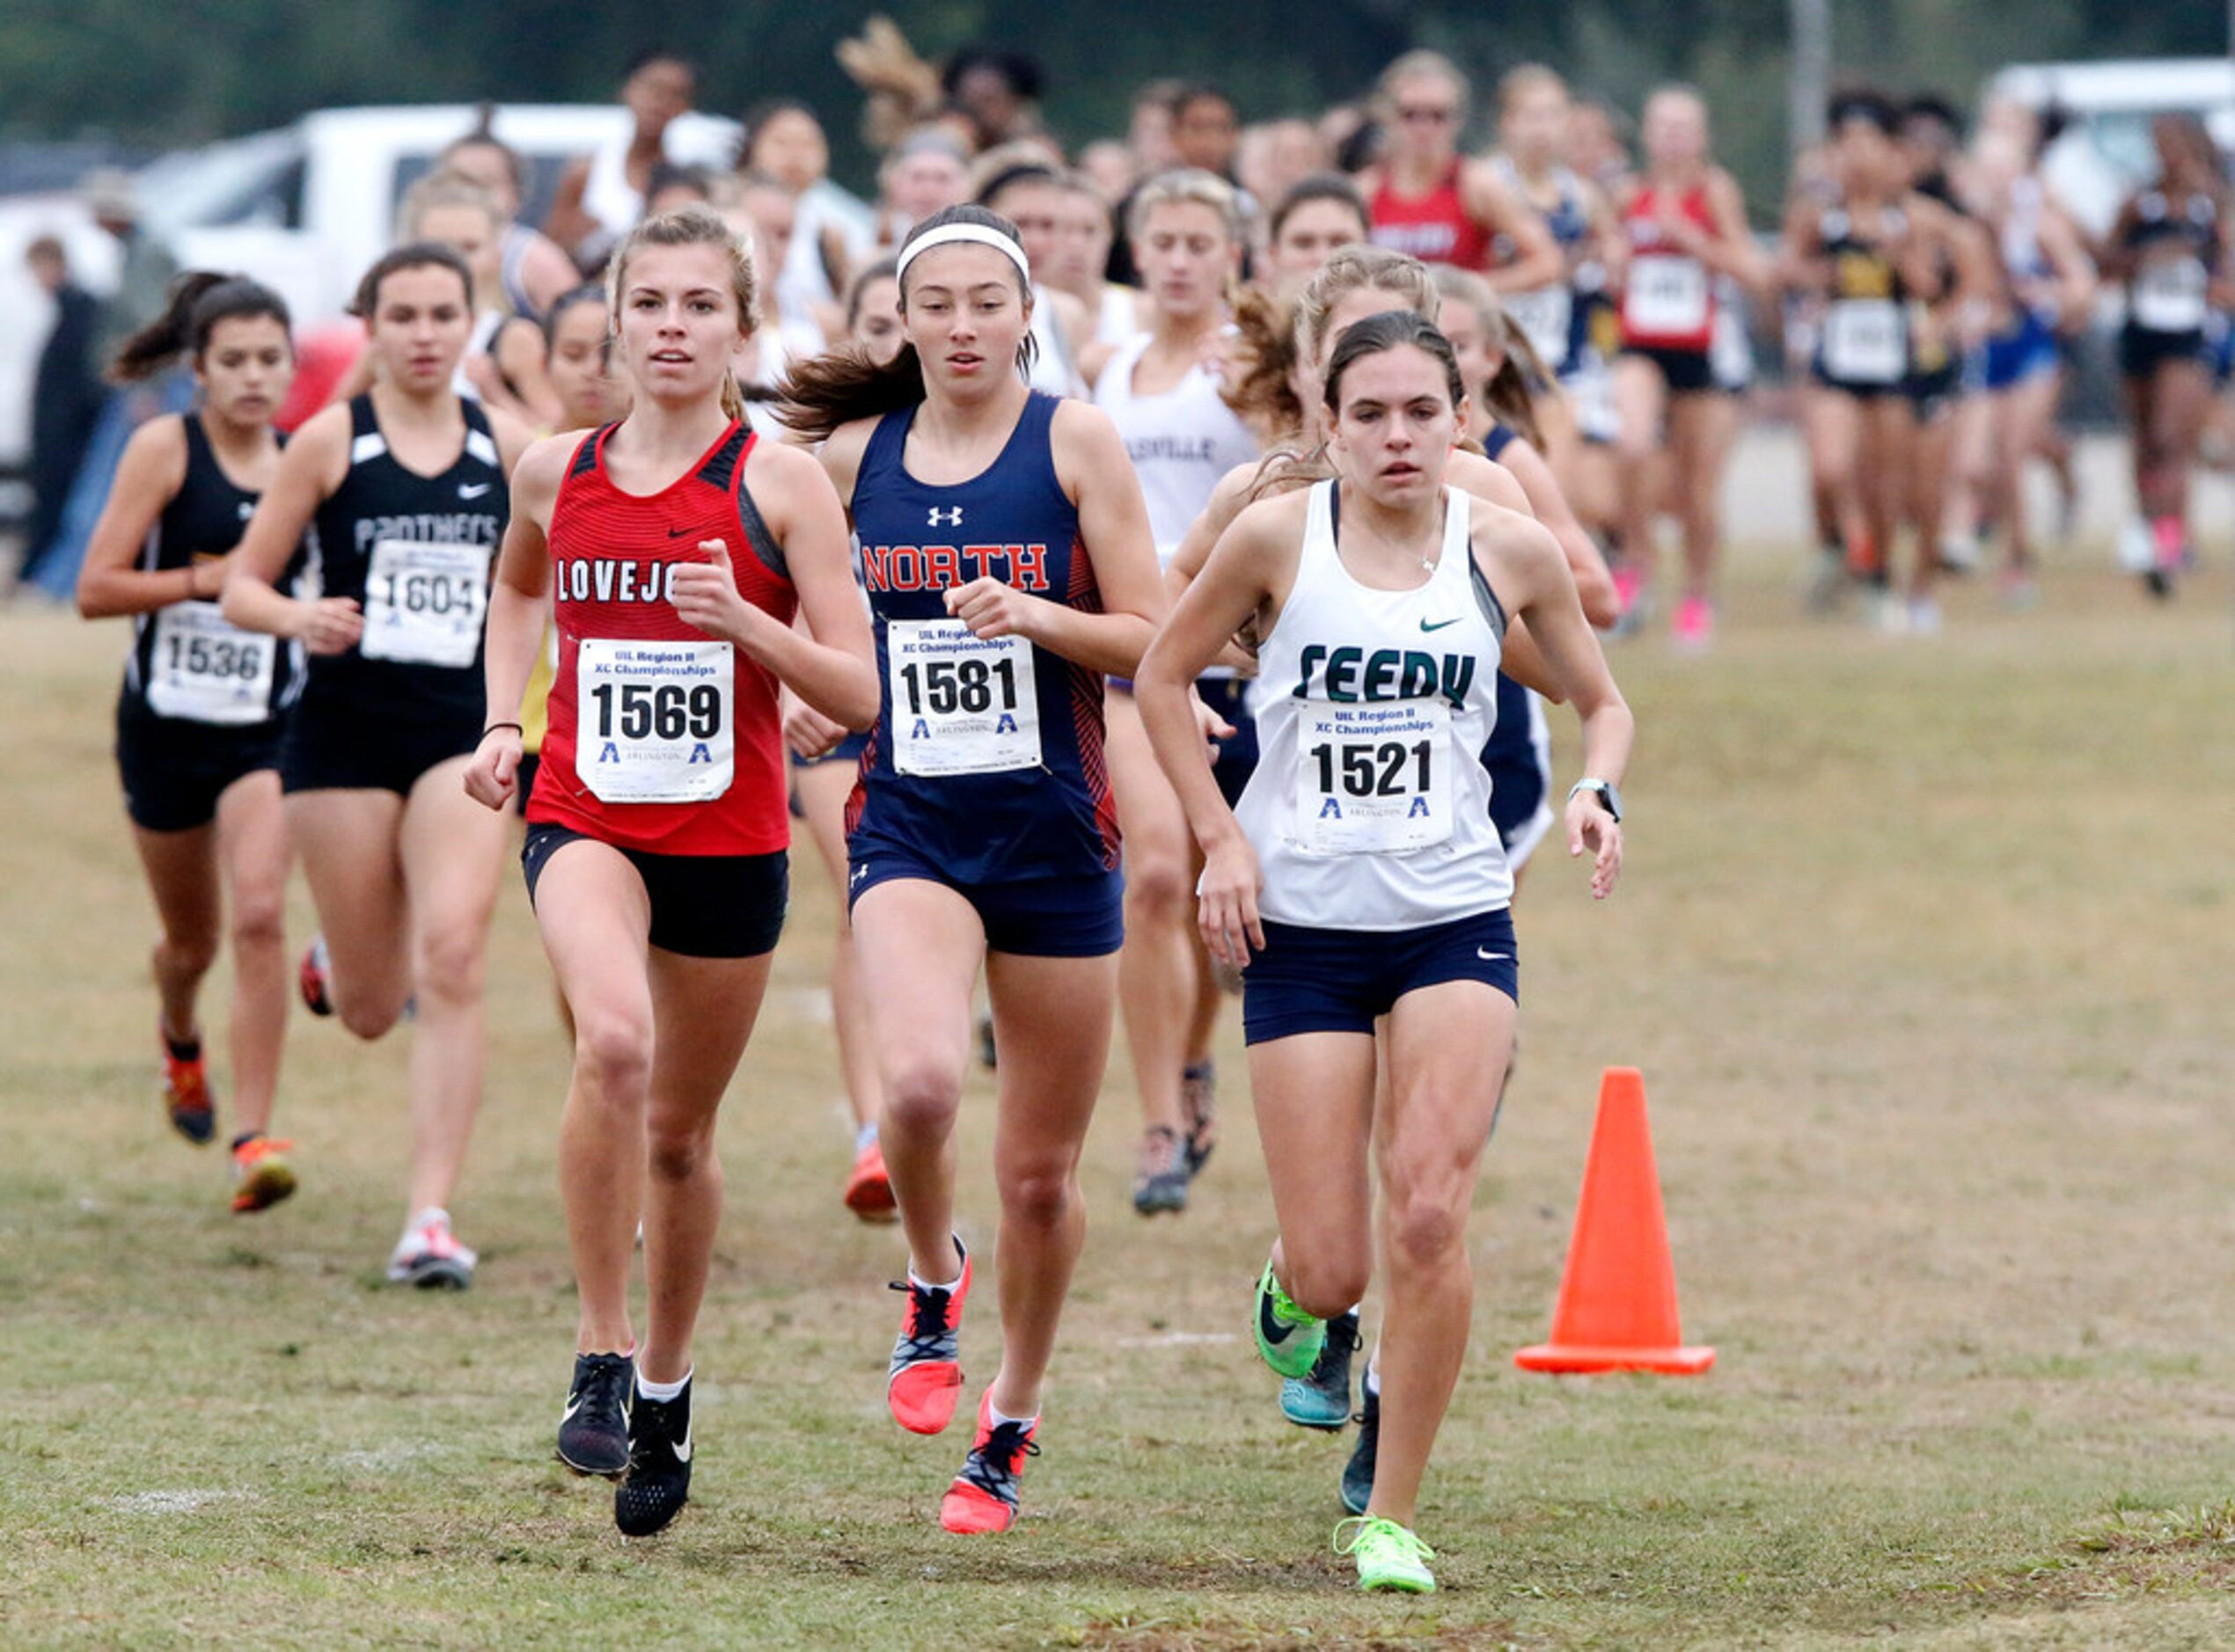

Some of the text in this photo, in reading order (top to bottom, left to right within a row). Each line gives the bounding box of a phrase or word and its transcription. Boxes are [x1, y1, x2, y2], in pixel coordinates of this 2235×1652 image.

[861, 544, 1051, 592] NORTH
[385, 575, 473, 613] 1604
[919, 630, 934, 640] UIL
[919, 639, 1015, 654] Championships
[170, 633, 260, 681] 1536
[595, 663, 716, 676] XC Championships
[615, 651, 634, 661] UIL
[637, 652, 683, 664] Region
[900, 658, 1017, 714] 1581
[591, 683, 722, 740] 1569
[1335, 711, 1355, 721] UIL
[1359, 710, 1404, 722] Region
[1315, 720, 1434, 735] XC Championships
[1311, 740, 1431, 797] 1521
